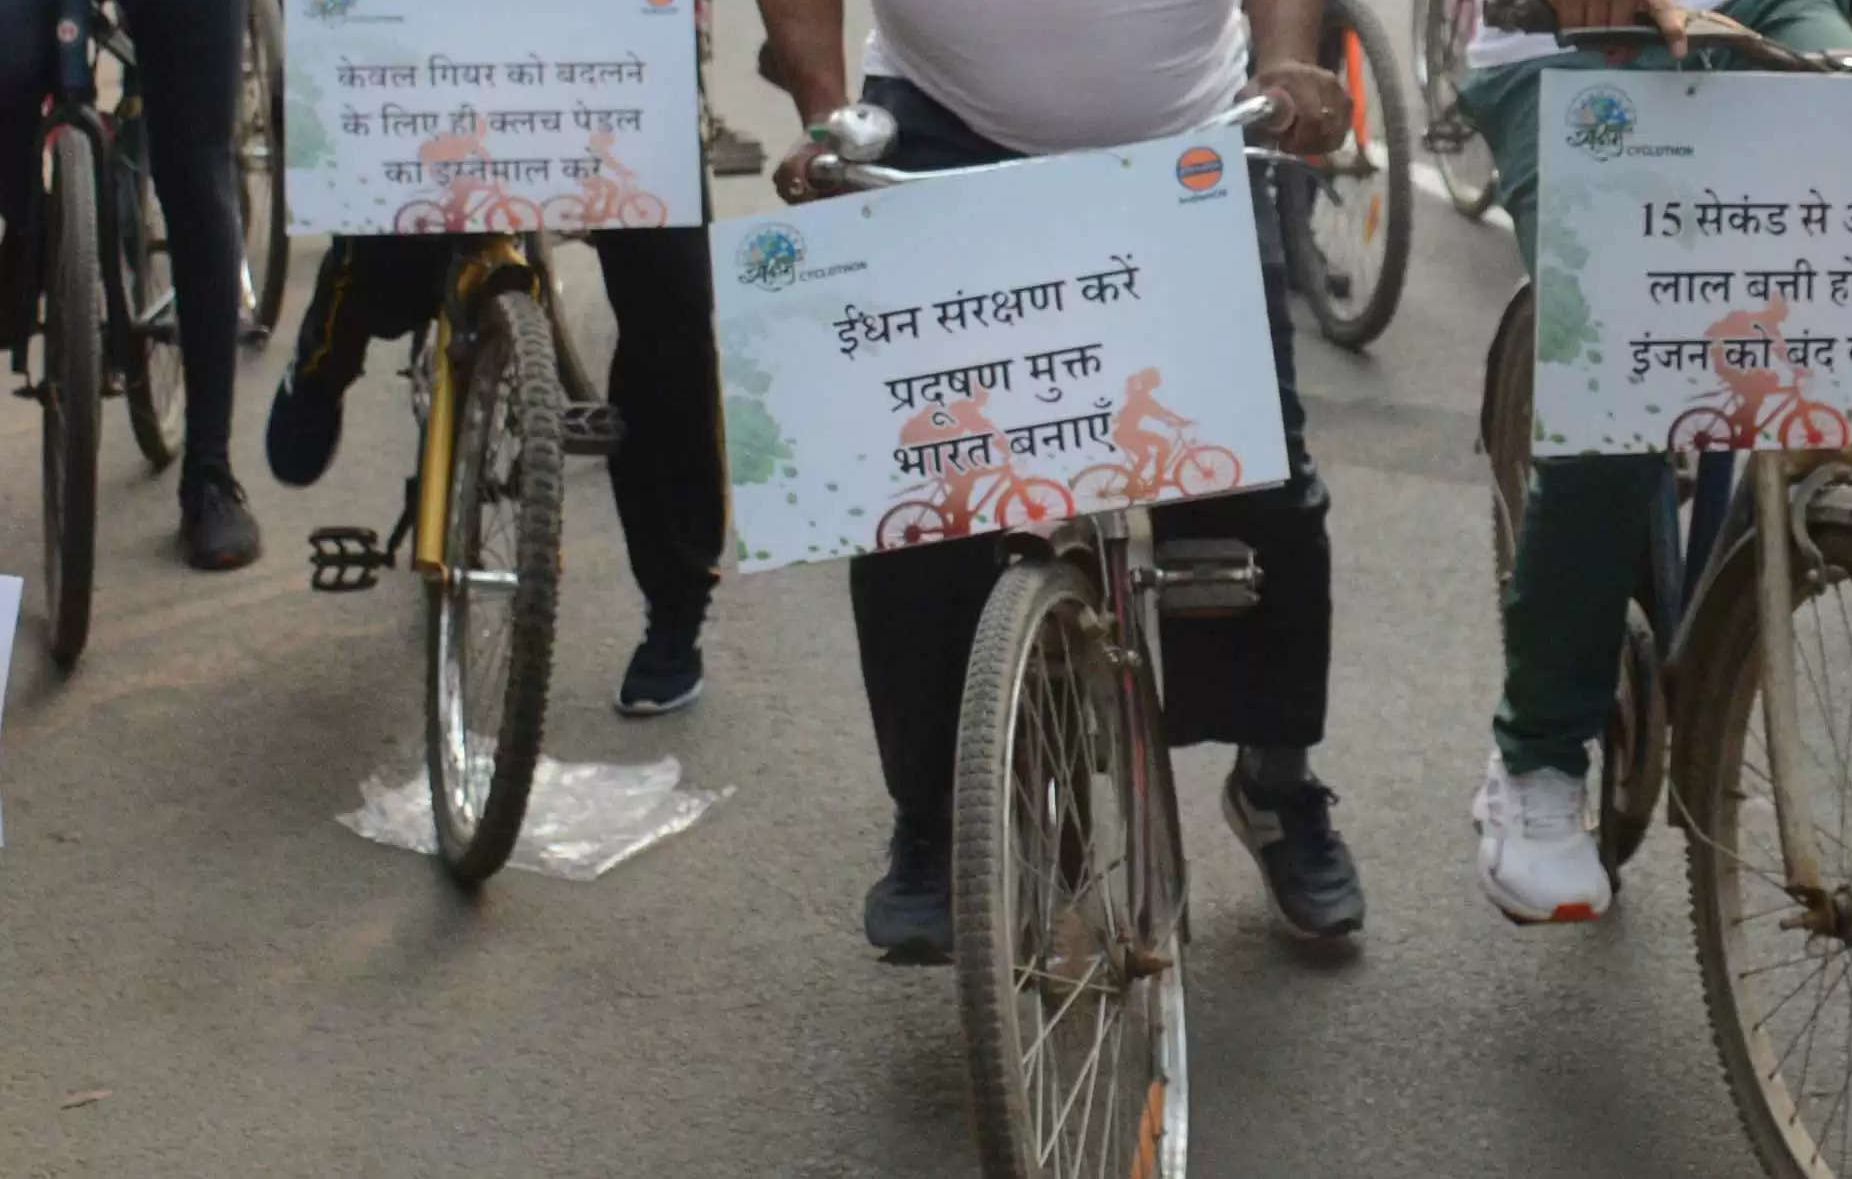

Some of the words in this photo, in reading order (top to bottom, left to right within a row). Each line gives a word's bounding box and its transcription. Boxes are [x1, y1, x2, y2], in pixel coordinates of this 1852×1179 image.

[336, 56, 418, 88] केवल
[427, 54, 496, 88] गियर
[505, 52, 548, 85] को
[555, 50, 647, 85] बदलने
[340, 103, 372, 136] के
[381, 102, 440, 141] लिए
[449, 102, 481, 134] ही
[1640, 200, 1683, 238] 15
[1694, 188, 1790, 238] सेकंड
[1798, 188, 1832, 236] से
[1646, 271, 1735, 305] लाल
[1745, 257, 1818, 304] बत्ती
[833, 303, 921, 360] ईंधन
[931, 277, 1066, 335] संरक्षण
[1076, 252, 1142, 303] करें
[1628, 332, 1710, 378] इंजन
[1721, 323, 1774, 371] को
[1784, 331, 1837, 373] बंद
[884, 356, 1012, 425] प्रदूषण
[1024, 340, 1103, 402] मुक्त
[891, 431, 993, 478] भारत
